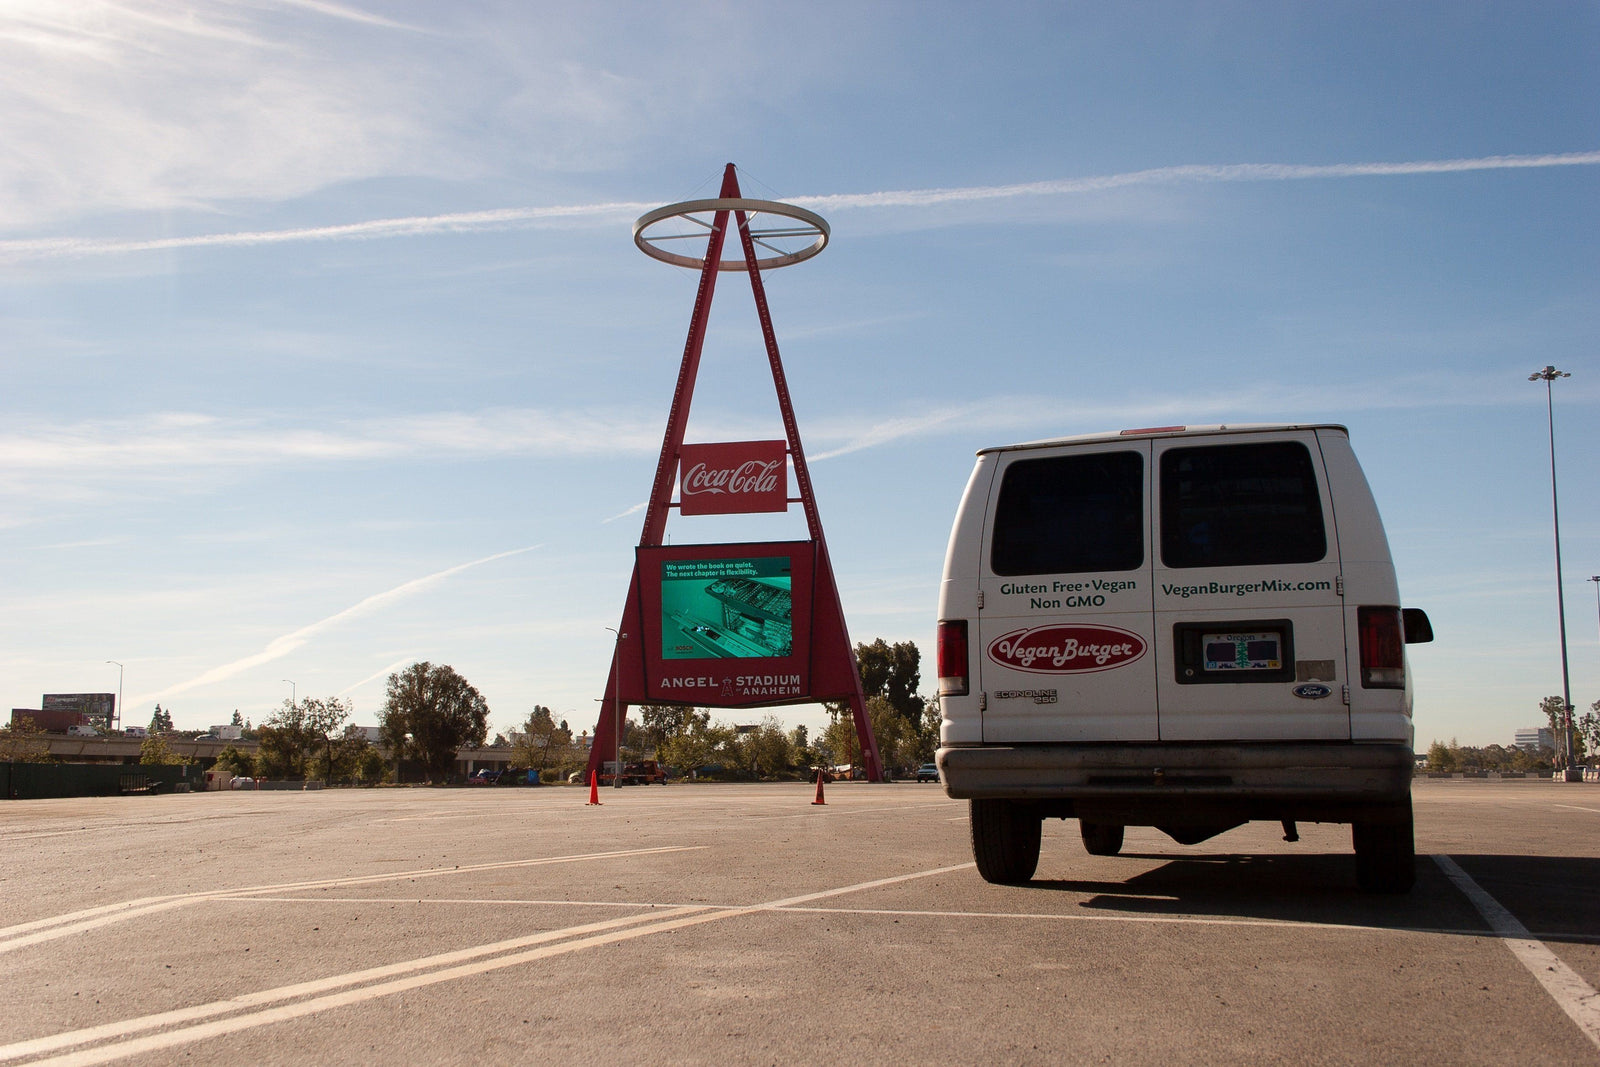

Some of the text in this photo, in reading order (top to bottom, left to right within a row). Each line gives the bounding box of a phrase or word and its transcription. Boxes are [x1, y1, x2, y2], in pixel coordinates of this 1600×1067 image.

[682, 460, 783, 495] Coca-Cola
[734, 561, 753, 570] quiet.
[694, 569, 718, 578] chapter
[726, 568, 758, 576] flexibility.
[1000, 583, 1047, 595] Gluten
[1162, 579, 1331, 598] VeganBurgerMix.com
[1030, 595, 1106, 609] Non GMO
[660, 677, 719, 688] ANGEL
[736, 674, 800, 687] STADIUM
[742, 686, 800, 696] ANAHEIM
[994, 689, 1057, 699] ECONOLINE
[1302, 686, 1322, 696] Ford
